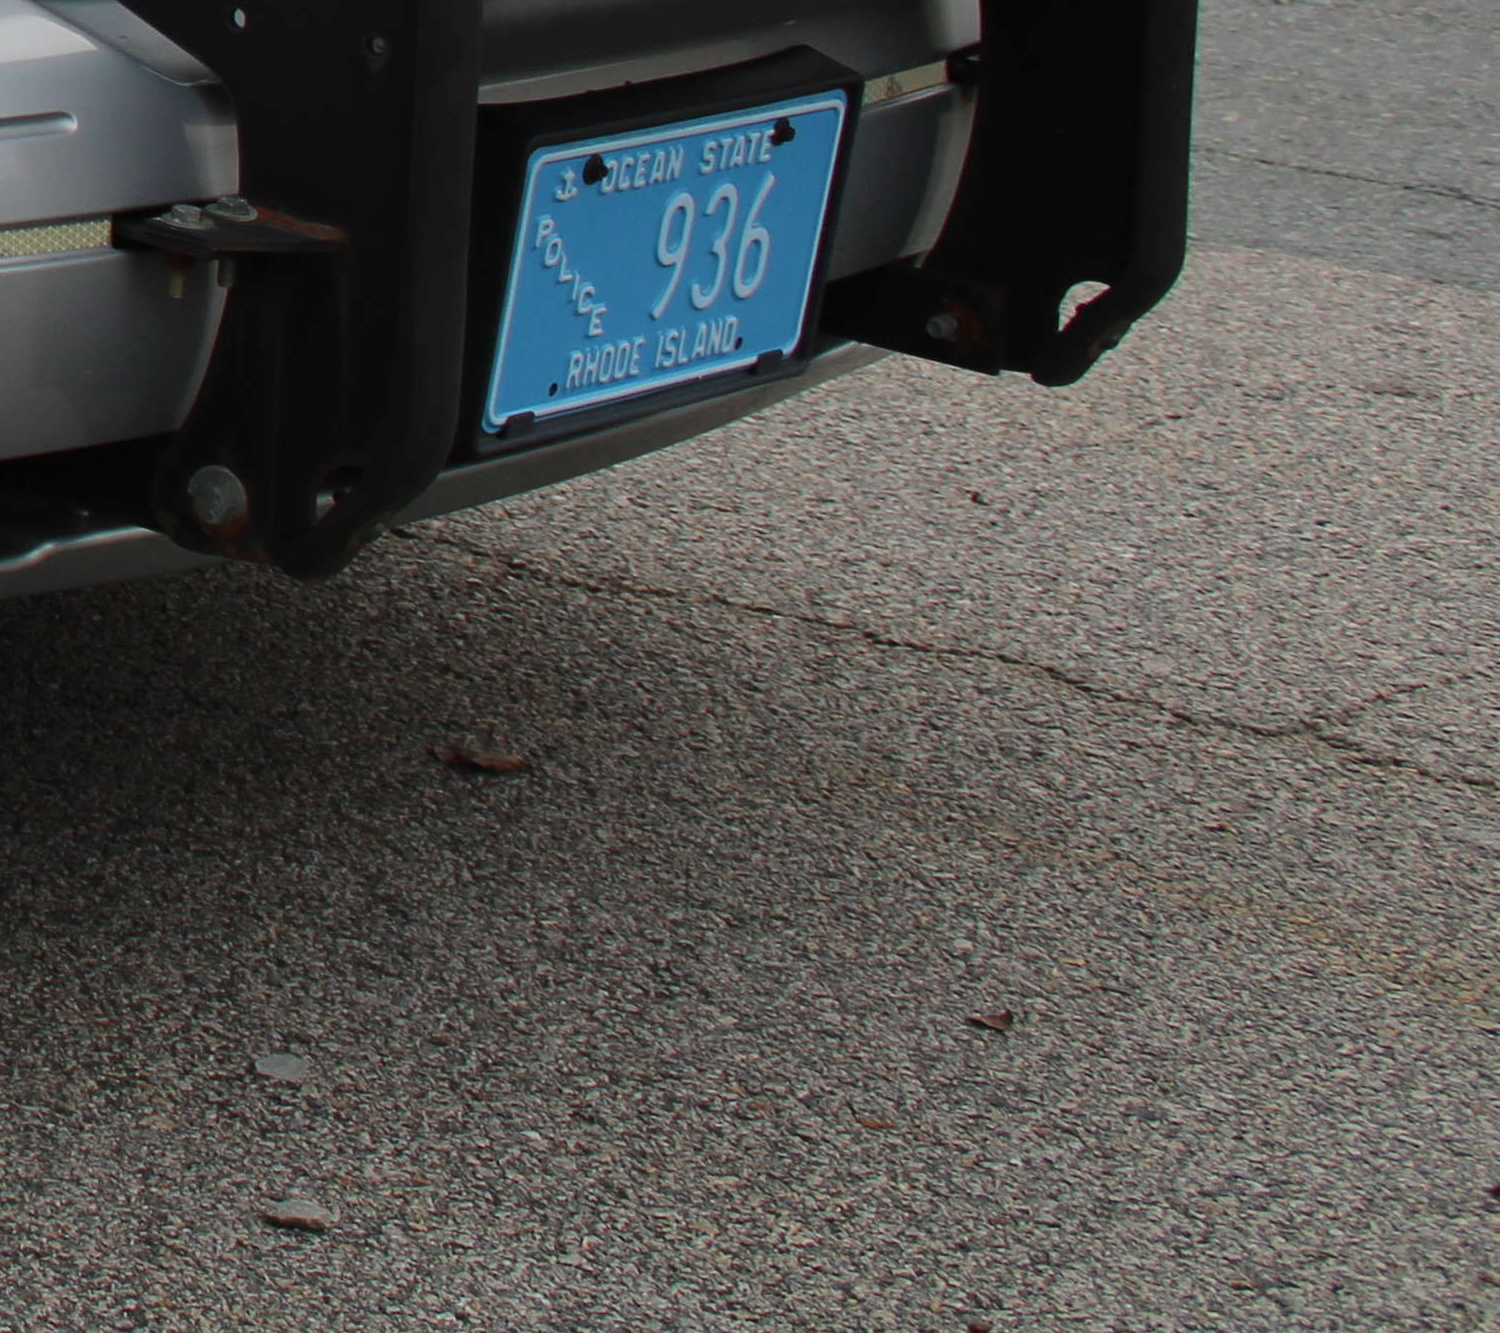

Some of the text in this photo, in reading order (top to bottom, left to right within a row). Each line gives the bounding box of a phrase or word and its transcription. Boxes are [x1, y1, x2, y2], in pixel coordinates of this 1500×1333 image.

[600, 129, 775, 194] OCEAN STATE
[535, 215, 607, 337] POLICE
[650, 171, 777, 320] 936
[566, 316, 738, 390] RHODE ISLAND
